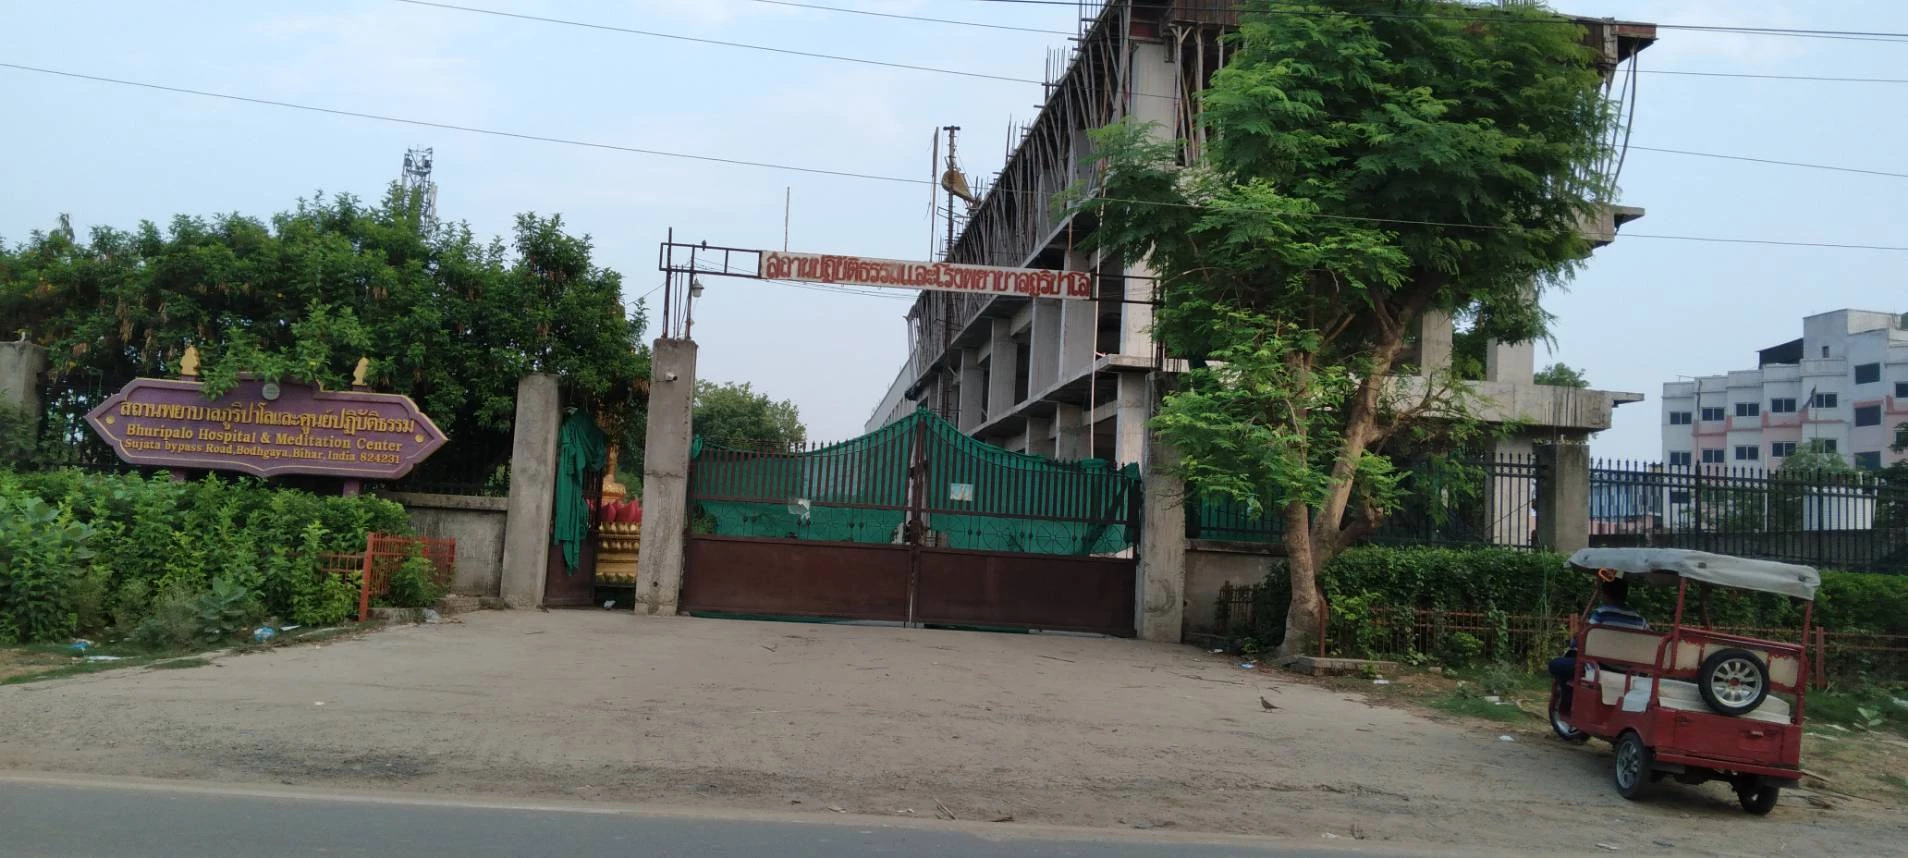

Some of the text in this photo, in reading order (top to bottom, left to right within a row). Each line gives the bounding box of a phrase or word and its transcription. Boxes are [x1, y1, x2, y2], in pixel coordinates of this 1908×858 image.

[126, 423, 403, 451] Bhuripalo Hospital & Meditation Center
[125, 439, 161, 451] Sujata
[164, 440, 202, 453] bypass
[327, 451, 356, 462] India
[360, 452, 401, 464] 824231
